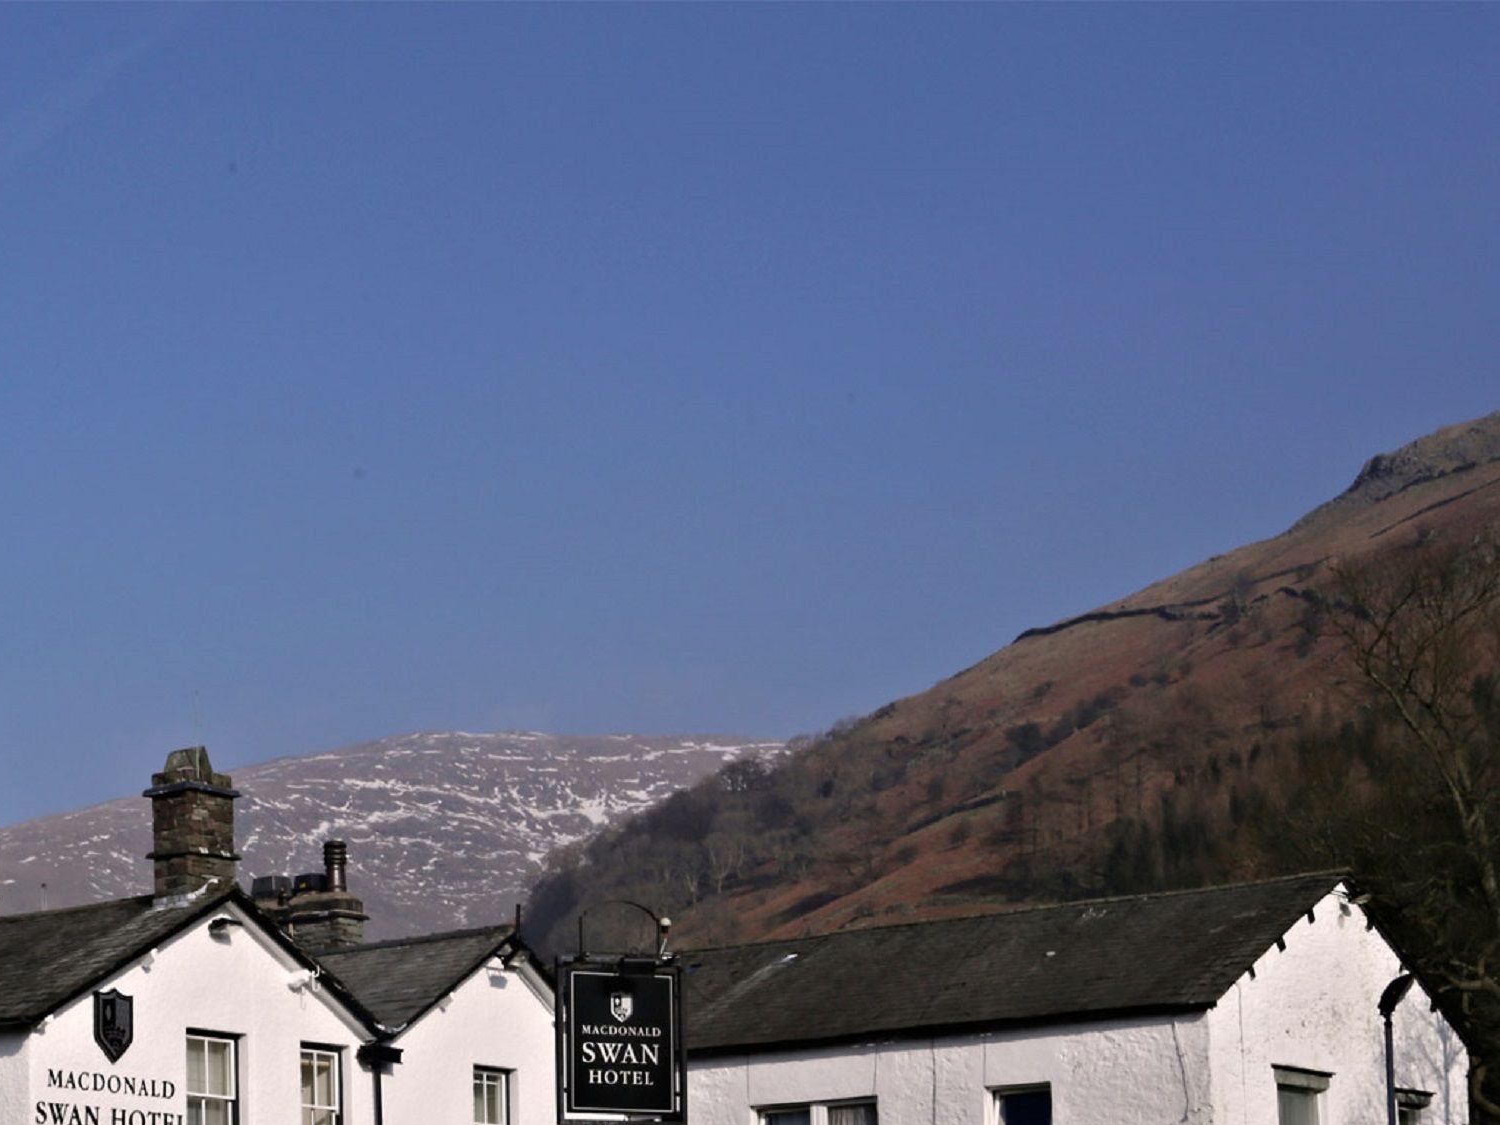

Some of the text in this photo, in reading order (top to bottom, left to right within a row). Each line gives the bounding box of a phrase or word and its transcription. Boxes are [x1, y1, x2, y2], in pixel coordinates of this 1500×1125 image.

[582, 1024, 662, 1037] MACDONALD
[582, 1041, 660, 1066] SWAN
[47, 1068, 175, 1099] MACDONALD
[588, 1069, 654, 1086] HOTEL
